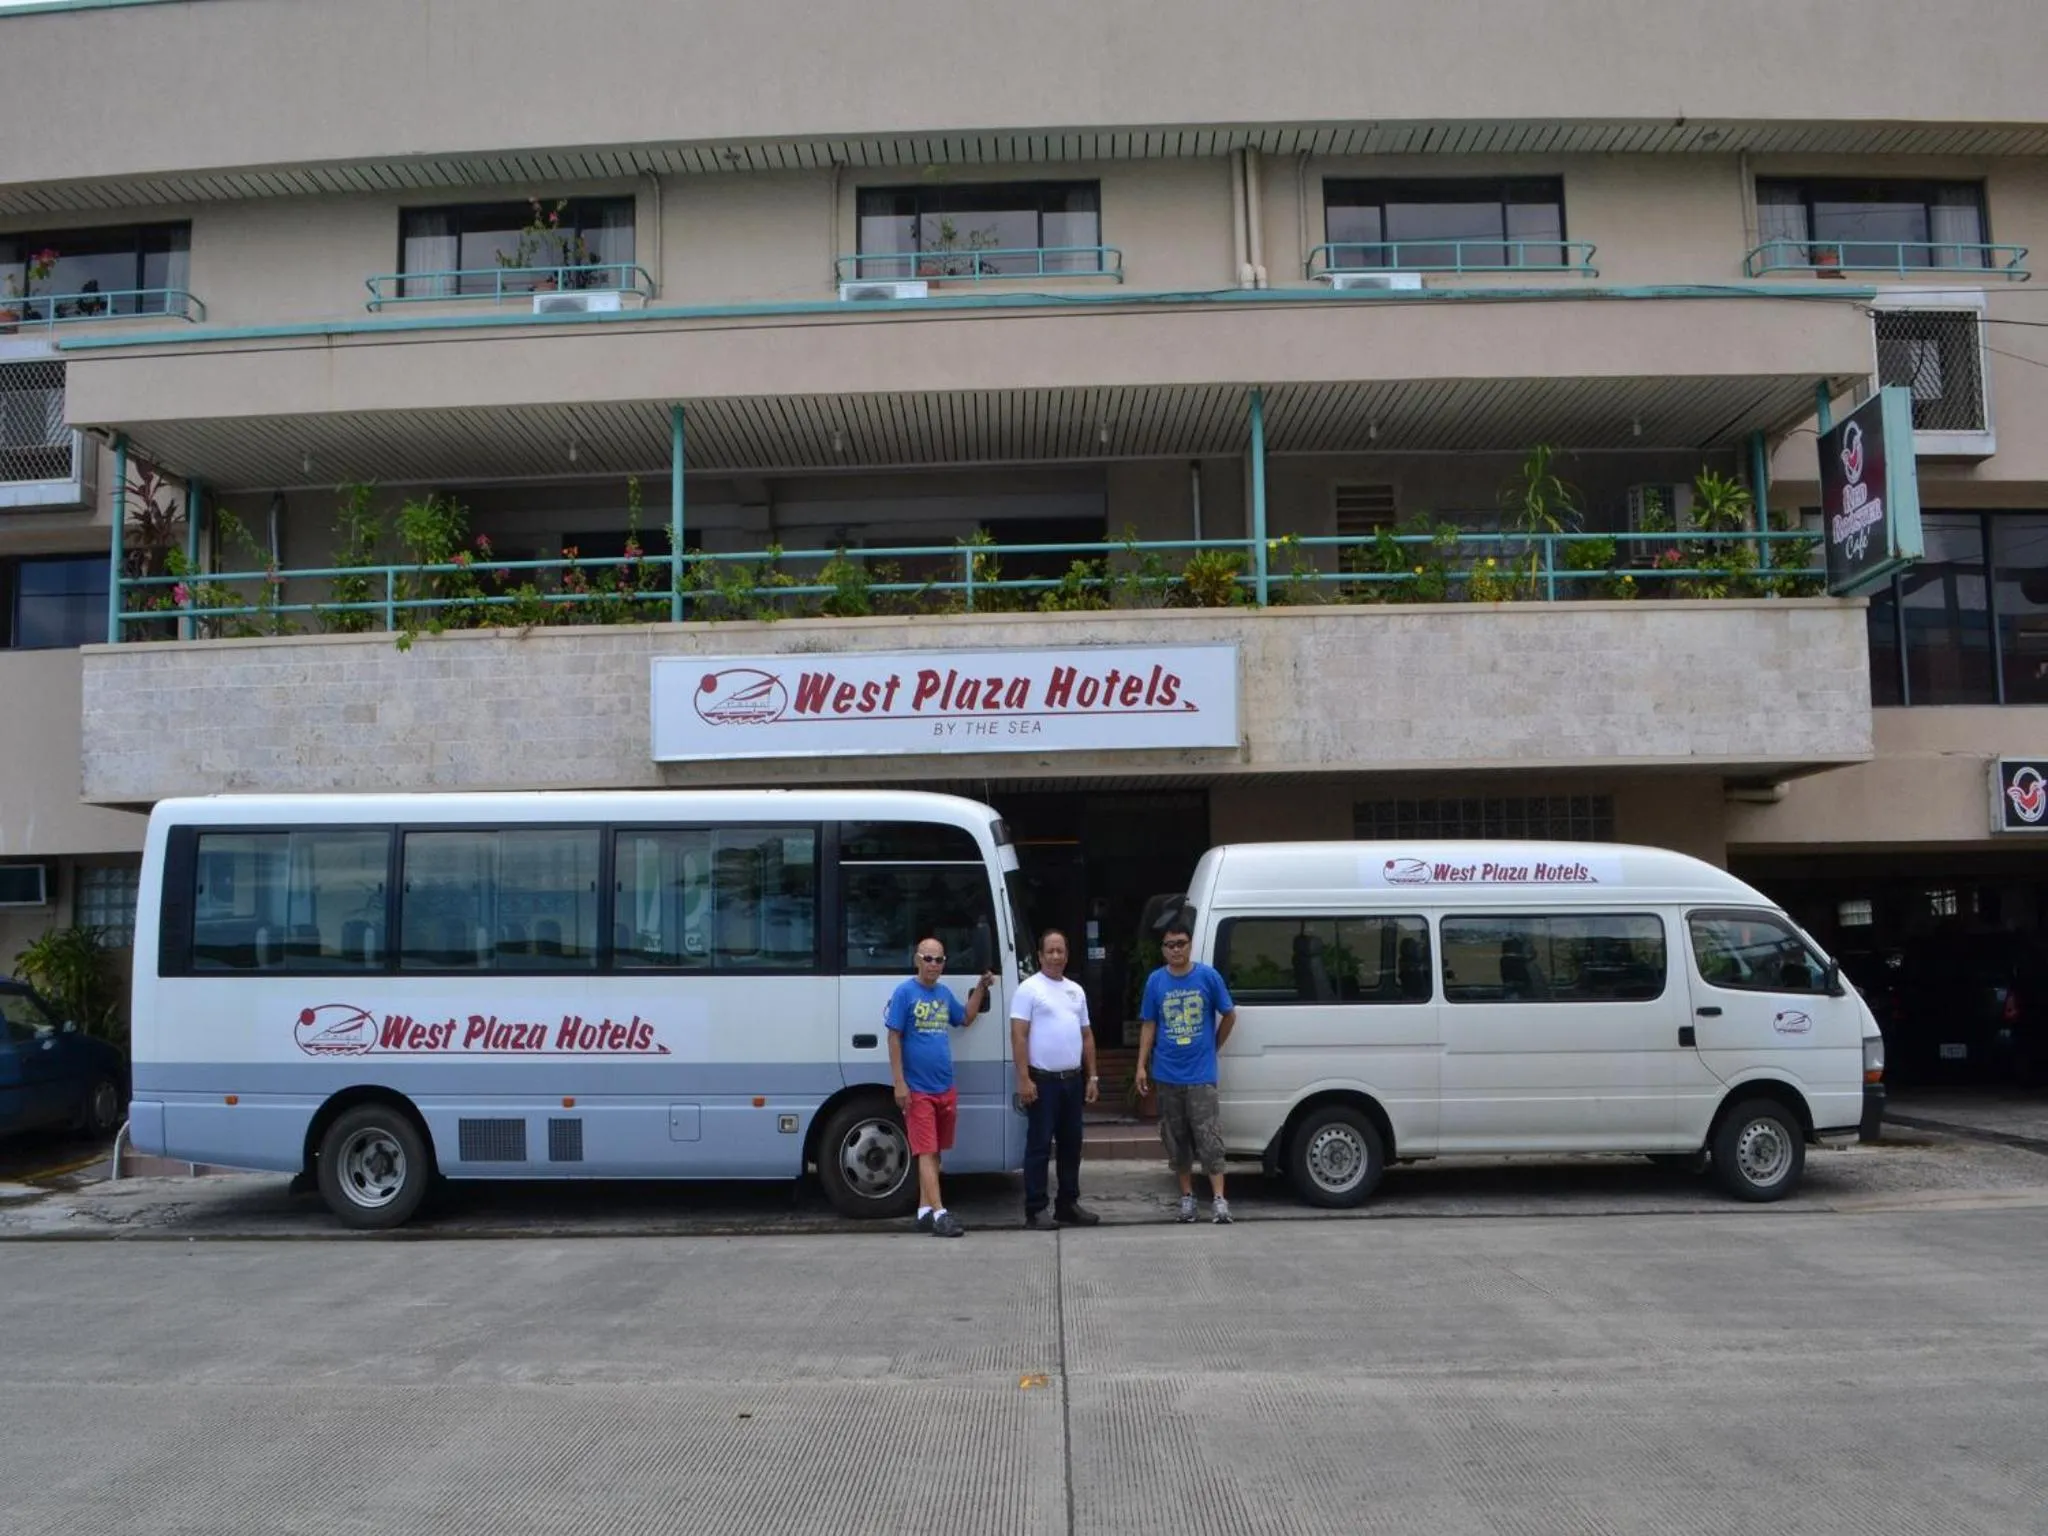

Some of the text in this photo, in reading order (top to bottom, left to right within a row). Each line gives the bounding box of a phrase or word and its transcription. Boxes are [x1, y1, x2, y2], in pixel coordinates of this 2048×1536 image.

[793, 664, 1181, 714] West Plaza Hotels
[933, 719, 1043, 736] BY THE SEA
[1433, 862, 1589, 881] West Plaza Hotels
[379, 1014, 655, 1050] West Plaza Hotels
